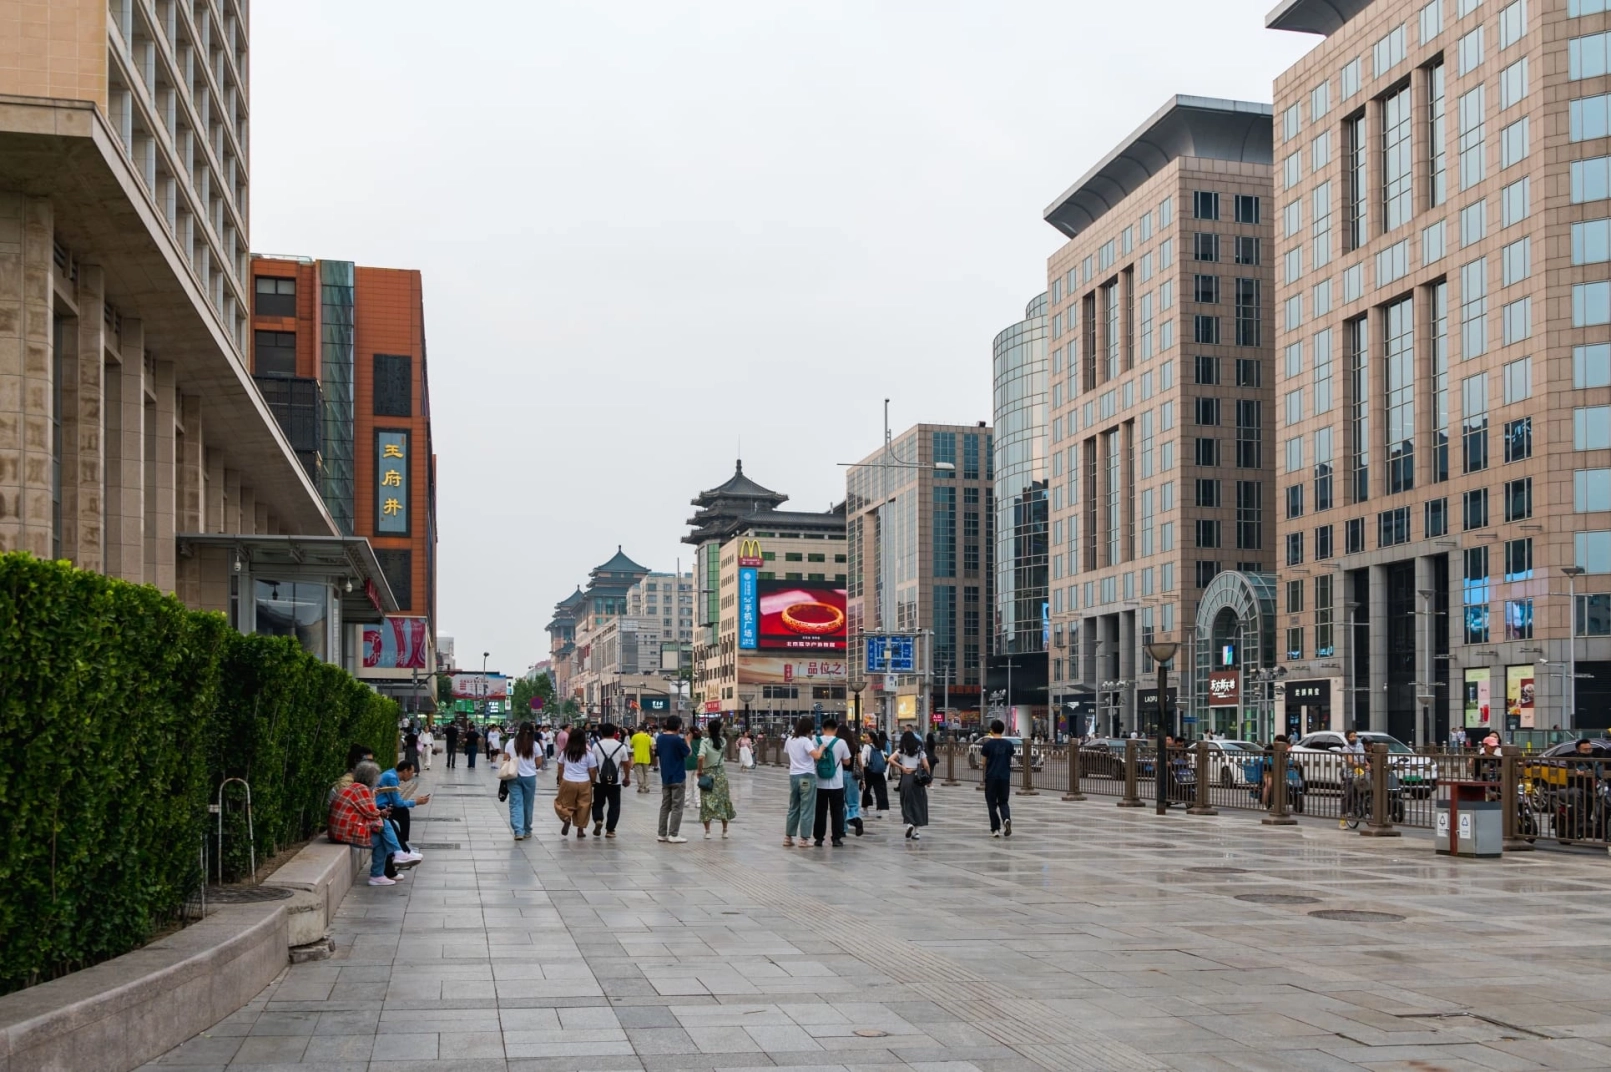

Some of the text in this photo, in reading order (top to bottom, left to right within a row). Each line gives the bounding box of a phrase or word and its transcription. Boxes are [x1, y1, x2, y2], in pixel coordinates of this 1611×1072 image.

[381, 444, 404, 516] 王府井
[808, 662, 846, 675] 品位之
